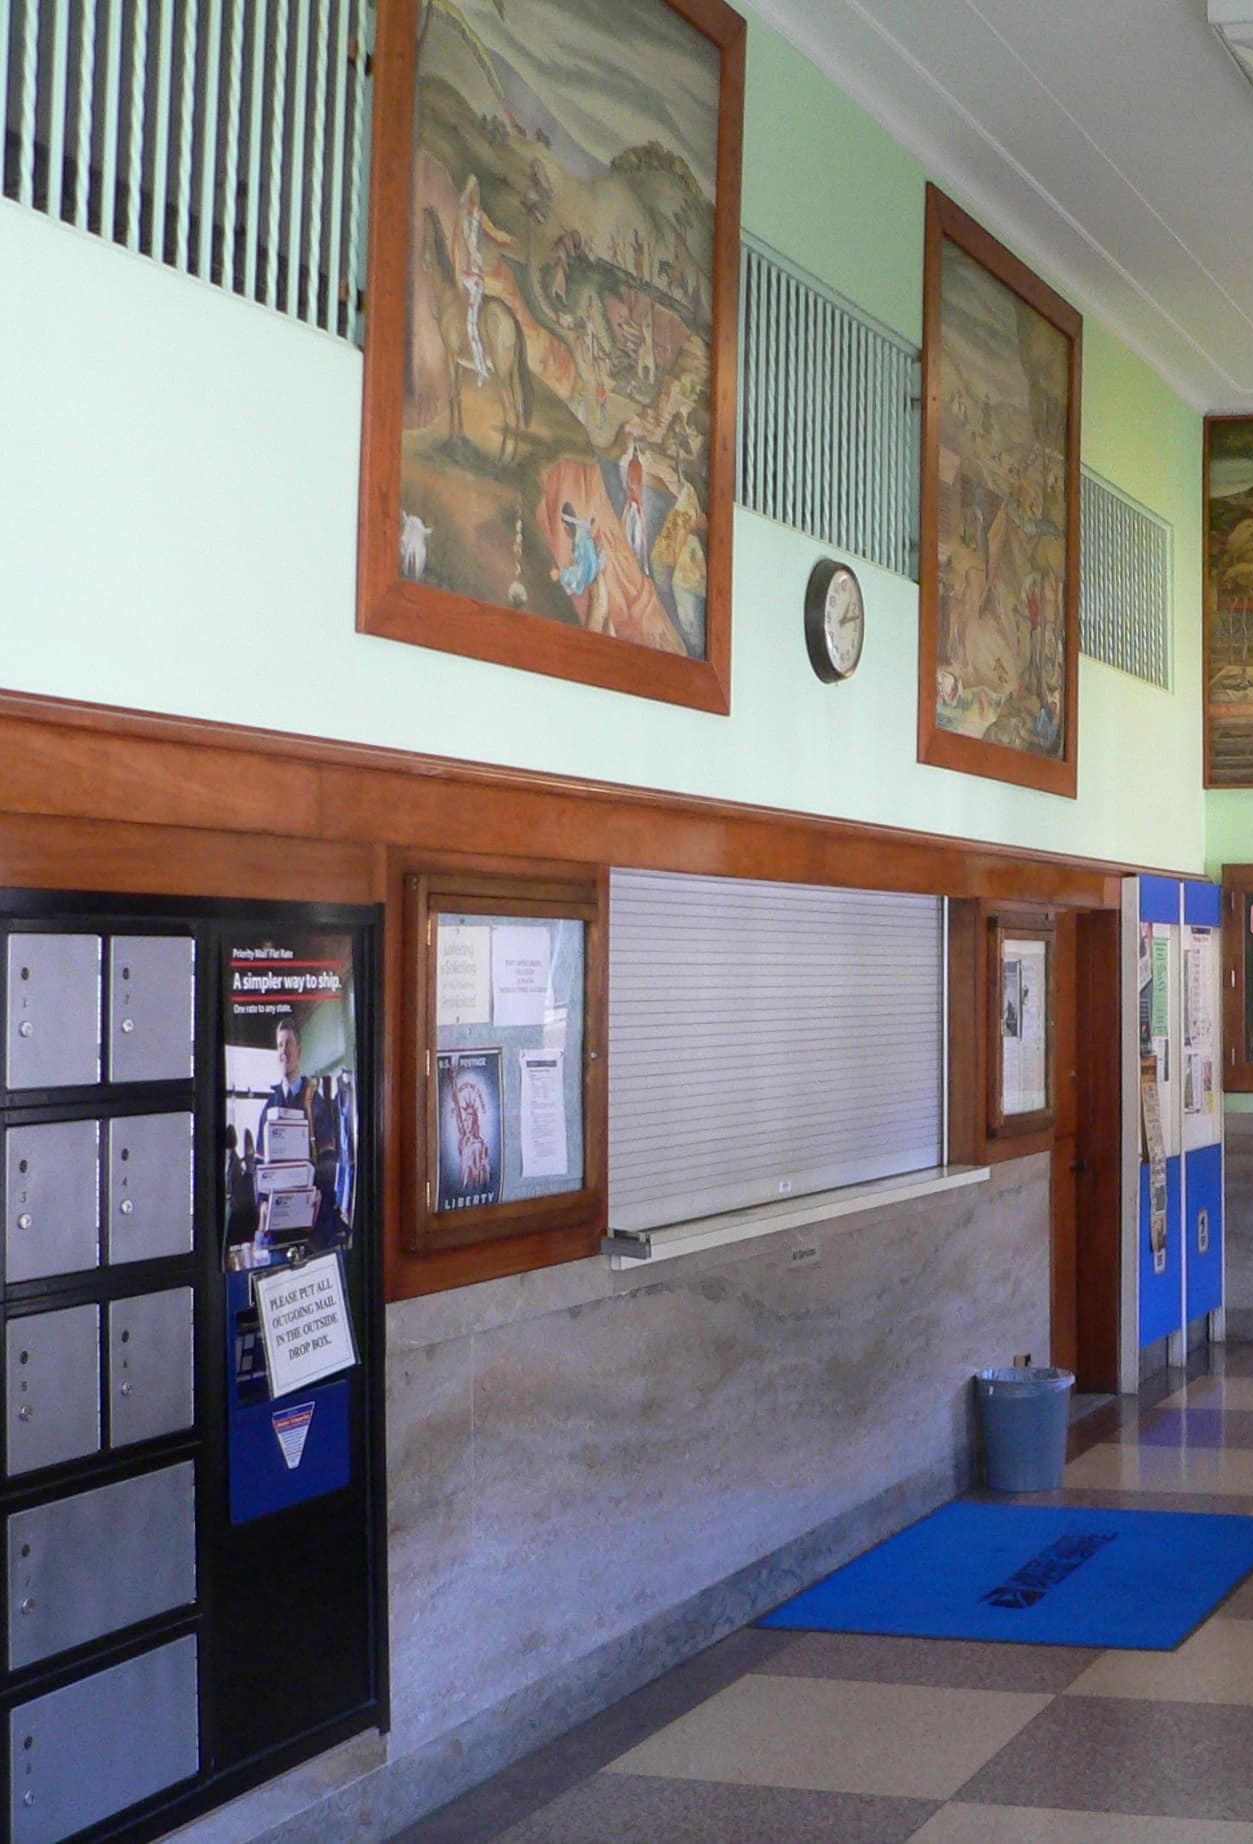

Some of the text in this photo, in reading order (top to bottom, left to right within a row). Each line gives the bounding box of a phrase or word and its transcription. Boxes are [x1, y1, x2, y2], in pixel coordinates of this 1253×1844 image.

[233, 971, 342, 993] A simpler way to ship.
[233, 1003, 246, 1014] One
[246, 1003, 258, 1013] rate
[265, 1004, 276, 1015] any
[444, 1192, 495, 1210] LIBERTY
[270, 1278, 333, 1312] PLEASE PUT ALL
[272, 1295, 337, 1329] OUTGOING MAIL
[276, 1312, 339, 1346] IN THE OUTSIDE
[288, 1334, 332, 1360] DROP BOX.
